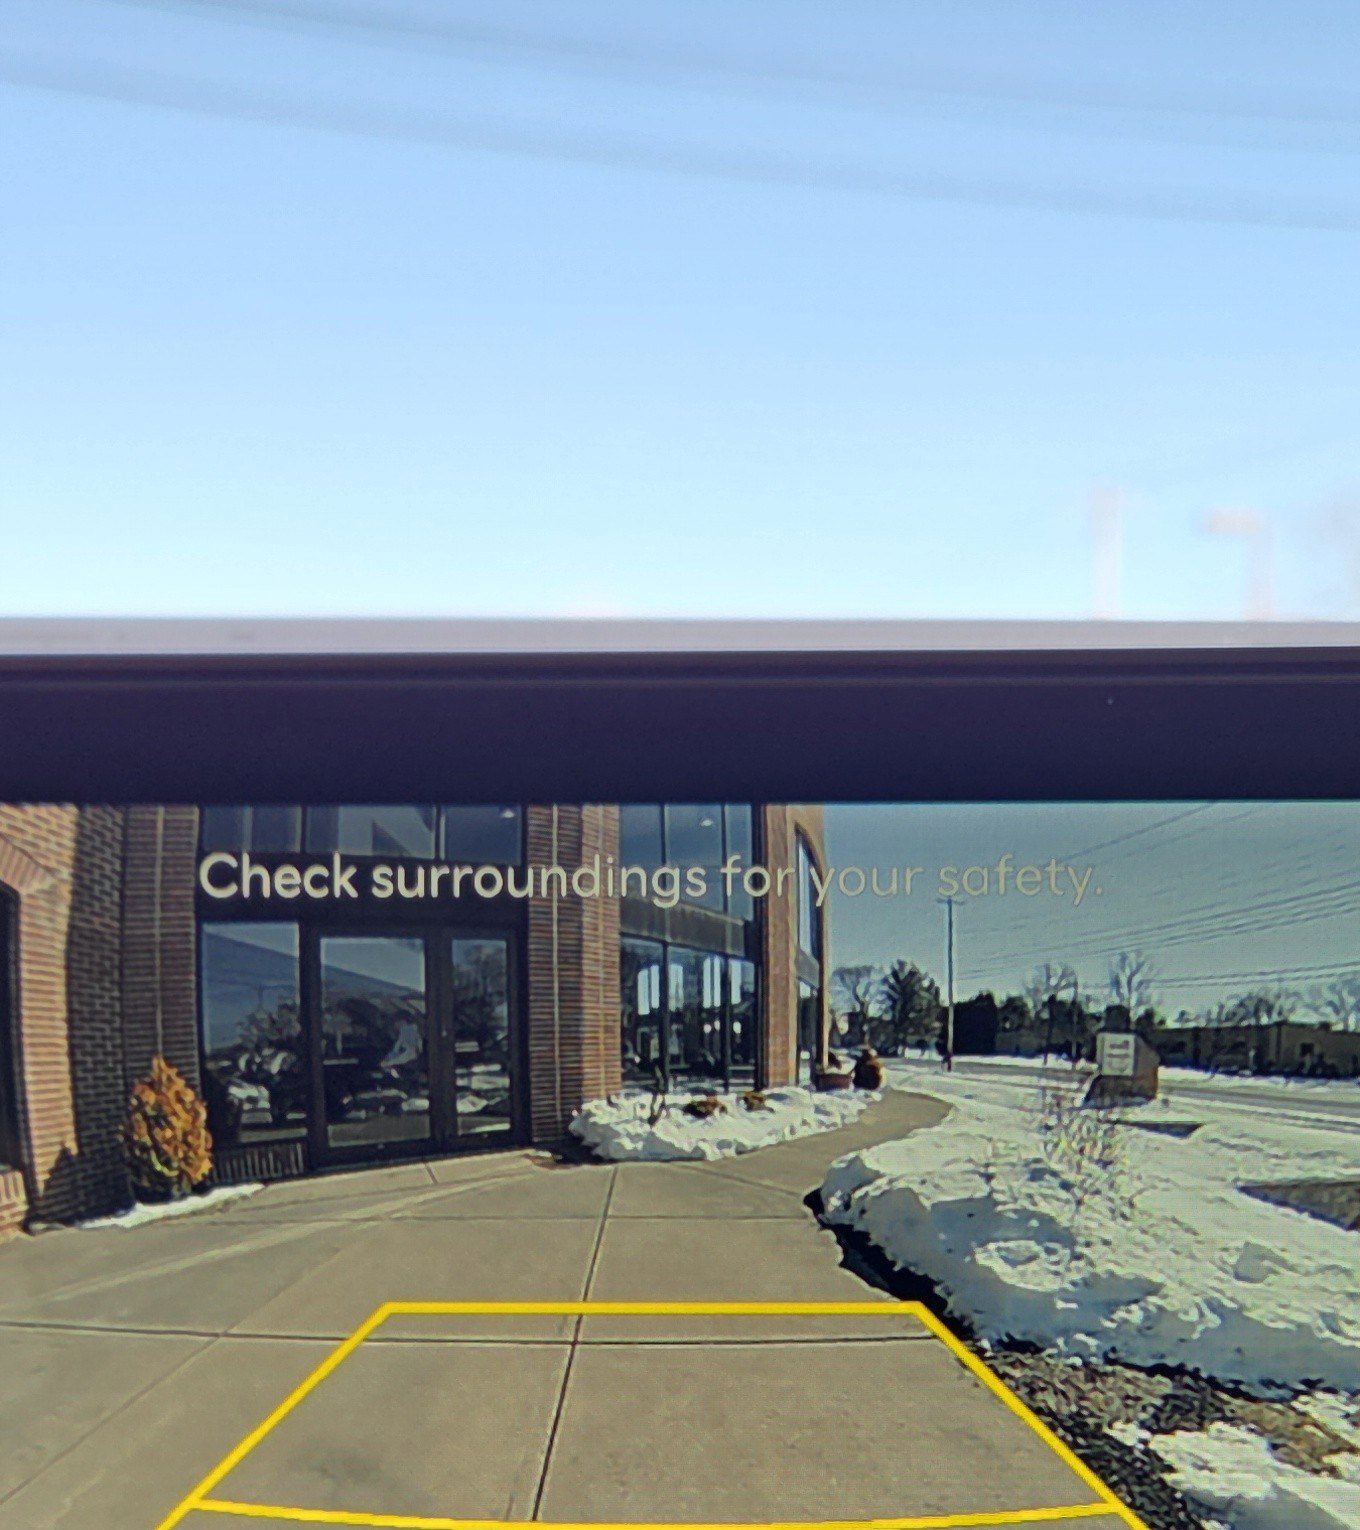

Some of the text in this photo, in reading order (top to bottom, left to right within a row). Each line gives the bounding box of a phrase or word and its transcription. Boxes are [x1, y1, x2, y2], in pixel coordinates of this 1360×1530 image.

[199, 851, 359, 899] Check
[371, 853, 707, 908] surroundings
[720, 854, 795, 898] for
[812, 865, 924, 907] your
